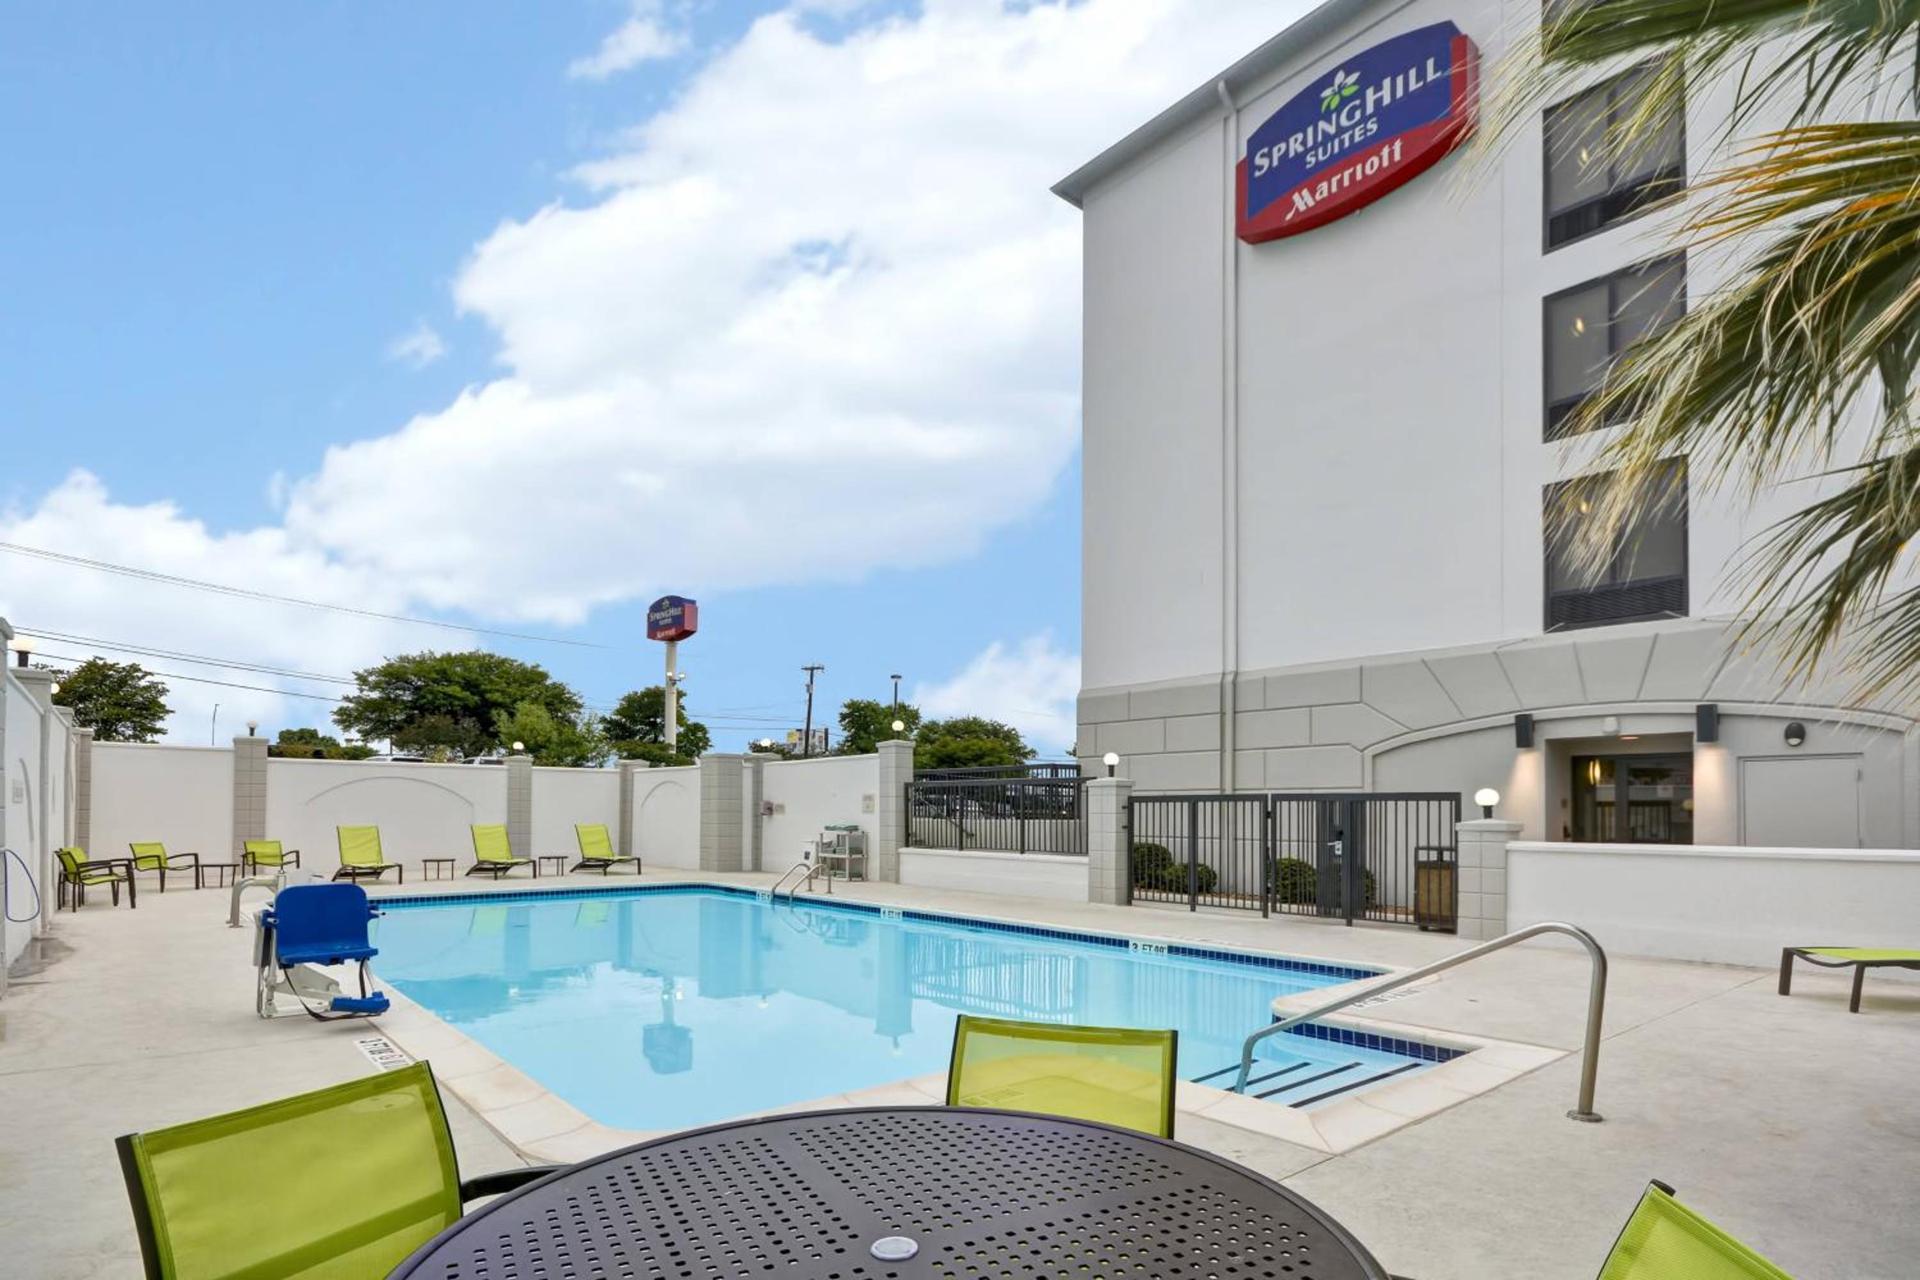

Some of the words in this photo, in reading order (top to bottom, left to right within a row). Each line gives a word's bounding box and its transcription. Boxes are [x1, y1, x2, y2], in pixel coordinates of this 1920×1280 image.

[1253, 56, 1442, 178] SPRINGHILL
[1305, 116, 1379, 169] SUITES
[1285, 138, 1403, 221] Marriott
